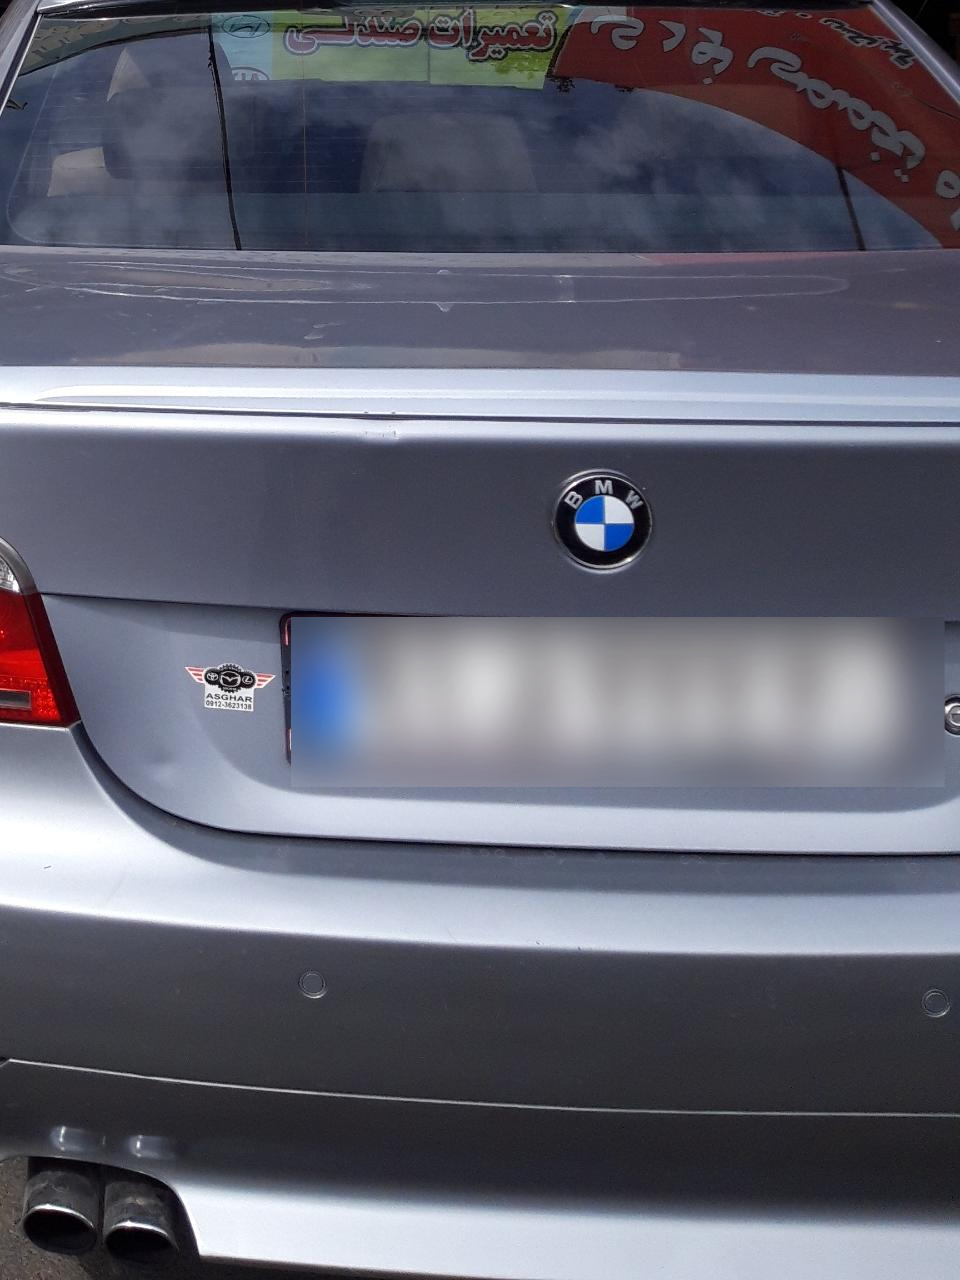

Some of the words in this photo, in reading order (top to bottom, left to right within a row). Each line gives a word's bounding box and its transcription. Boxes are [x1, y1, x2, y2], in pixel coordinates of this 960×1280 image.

[429, 7, 560, 62] تعمیرات
[564, 479, 644, 510] BMW
[205, 692, 253, 703] ASGHAR
